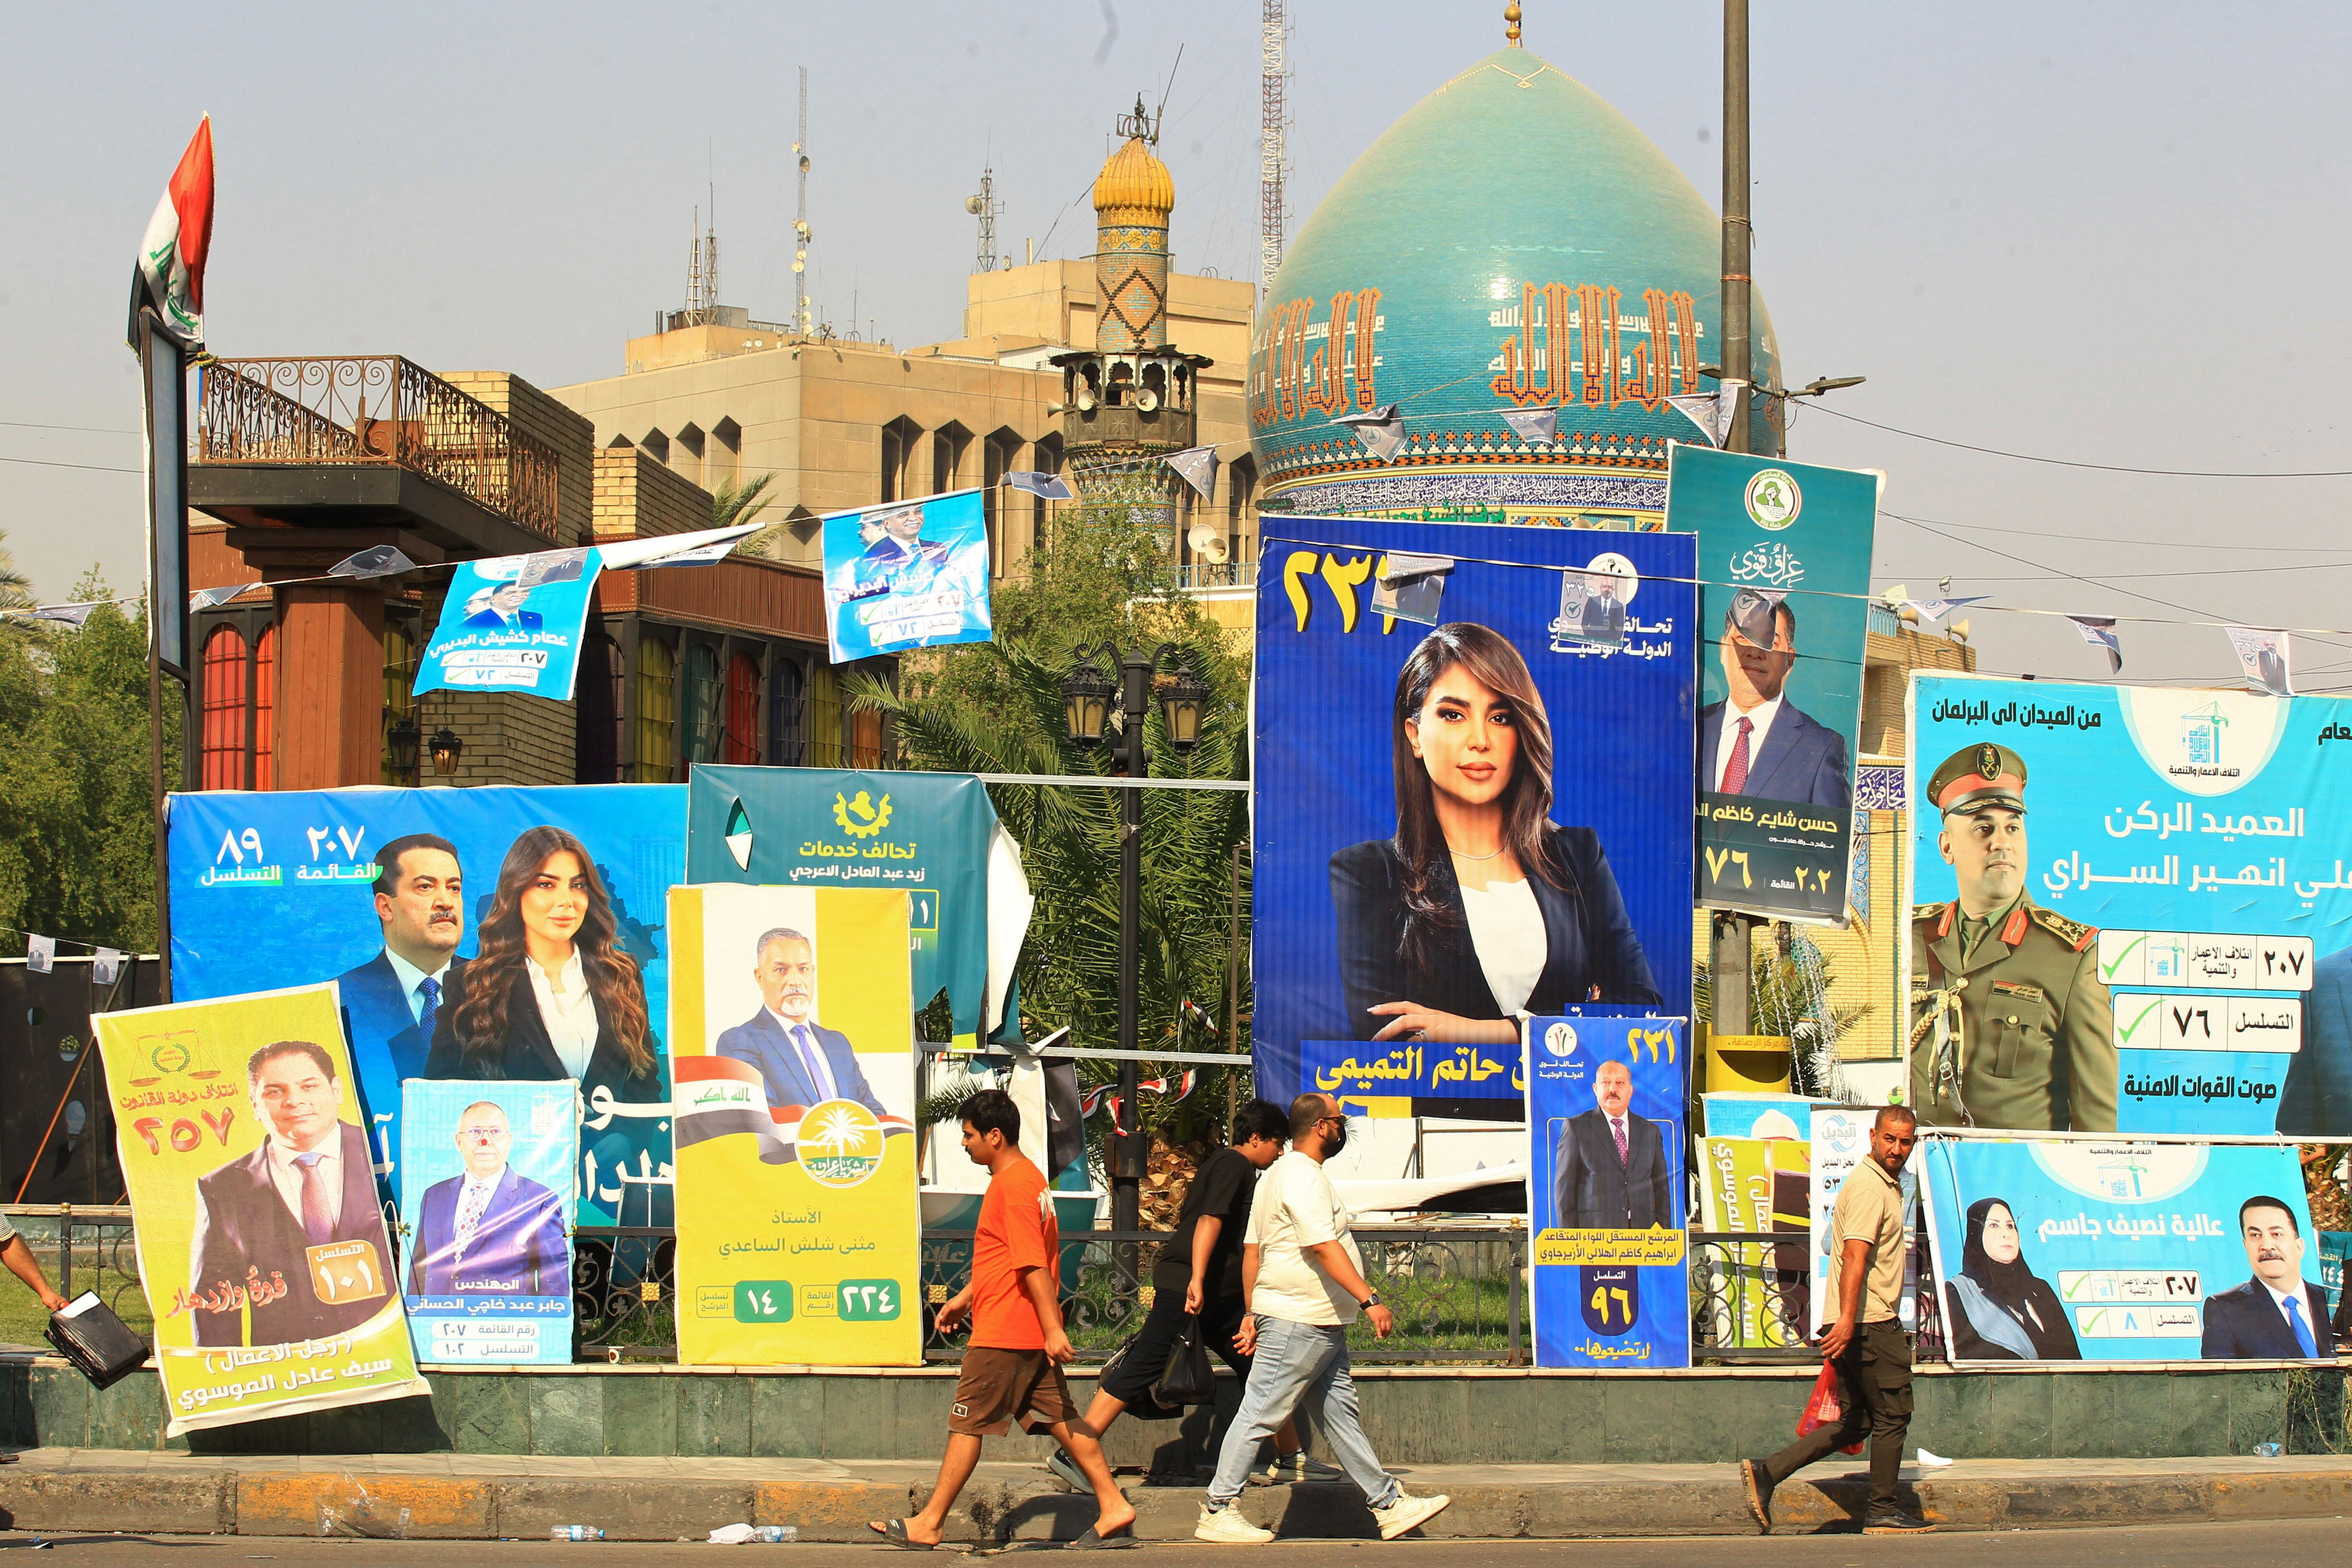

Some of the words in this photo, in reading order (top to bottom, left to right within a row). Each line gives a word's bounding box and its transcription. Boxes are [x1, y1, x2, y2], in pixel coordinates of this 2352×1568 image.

[1565, 582, 1595, 599] ٣٢٥
[479, 629, 529, 646] كشيش
[898, 622, 917, 636] ٧٢
[429, 634, 476, 659] البديري
[531, 631, 568, 646] عصام
[1623, 638, 1672, 660] الدولة
[521, 653, 545, 664] ٢٠٧
[476, 670, 495, 680] ٧٢
[1932, 697, 1989, 726] البرلمان
[1991, 702, 2016, 726] الى
[2020, 703, 2075, 731] الميدان
[2077, 709, 2101, 730] من
[1695, 802, 1709, 817] ال
[1712, 806, 1754, 822] كاظم
[1756, 810, 1797, 830] شايع
[1798, 815, 1838, 833] حسن
[2104, 800, 2193, 840] الركن
[2200, 807, 2304, 842] العميد
[216, 827, 264, 865] ٨٩
[306, 825, 365, 862] ٢٠٧
[799, 840, 859, 858] خدمات
[862, 841, 918, 859] تحالف
[200, 864, 281, 886] التسلسل
[296, 862, 377, 880] القائمة
[788, 865, 839, 882] الاعرجي
[841, 865, 880, 880] العادل
[882, 868, 905, 881] عبد
[905, 867, 926, 882] زيد
[1704, 846, 1753, 889] ٧٦
[2042, 850, 2179, 900] السراي
[2188, 857, 2285, 892] انهير
[1770, 880, 1795, 890] القائمة
[1794, 866, 1831, 895] ٢٠٢
[2293, 859, 2352, 908] لي
[2190, 946, 2221, 962] الاعمار
[2225, 946, 2252, 960] ائتلاف
[2202, 960, 2237, 979] والتنمية
[2263, 949, 2304, 976] ٢٠٧
[2172, 1005, 2211, 1040] ٧٦
[2235, 1011, 2294, 1033] التسلسل
[1627, 1028, 1676, 1064] ٢٣١
[1432, 1046, 1505, 1089] حاتم
[1538, 1070, 1563, 1079] الوطنية
[1563, 1070, 1584, 1079] الدولة
[200, 1082, 239, 1100] ائتلاف
[2124, 1073, 2179, 1102] الامنية
[2181, 1075, 2235, 1103] القوات
[2237, 1079, 2277, 1105] صوت
[119, 1090, 166, 1111] القانون
[167, 1088, 199, 1106] دولة
[133, 1106, 235, 1156] ٢٥٧
[1821, 1158, 1841, 1170] البديل
[1843, 1157, 1855, 1169] نحن
[1824, 1177, 1840, 1191] ٥٣
[772, 1205, 822, 1224] الأستاذ
[1544, 1230, 1581, 1241] المتقاعد
[2038, 1212, 2102, 1243] جاسم
[2107, 1212, 2166, 1241] نصيف
[2170, 1213, 2225, 1241] عالية
[790, 1236, 834, 1255] شلش
[839, 1236, 876, 1255] مثنى
[1582, 1232, 1604, 1244] اللواء
[1606, 1230, 1646, 1244] المستقل
[1647, 1231, 1679, 1245] المرشح
[315, 1243, 366, 1263] التسلسل
[718, 1238, 785, 1261] الساعدي
[1586, 1246, 1617, 1264] الهلالي
[1618, 1246, 1642, 1262] كاظم
[1644, 1248, 1676, 1263] ابراهيم
[319, 1259, 374, 1301] ١٠١
[454, 1278, 520, 1290] المهندس
[1593, 1270, 1626, 1282] التسلسل
[2165, 1276, 2197, 1295] ٢٠٧
[165, 1278, 247, 1319] وازدهار
[700, 1292, 729, 1301] تسلسل
[747, 1288, 778, 1315] ١٤
[806, 1291, 834, 1300] القائمة
[842, 1285, 896, 1314] ٢٢٤
[405, 1298, 465, 1316] الحساني
[509, 1301, 535, 1312] عبد
[537, 1299, 566, 1313] جابر
[700, 1302, 729, 1312] المرشح
[806, 1301, 834, 1311] رقم
[1590, 1286, 1632, 1325] ٩٦
[443, 1323, 466, 1336] ٢٠٧
[478, 1325, 514, 1334] القائمة
[2124, 1312, 2139, 1330] ٨
[2156, 1314, 2195, 1327] التسلسل
[517, 1324, 535, 1338] رقم
[445, 1343, 465, 1356] ١٠٢
[480, 1344, 533, 1356] التسلسل
[341, 1358, 393, 1380] سيف
[282, 1366, 336, 1391] عادل
[177, 1373, 277, 1411] الموسوي
